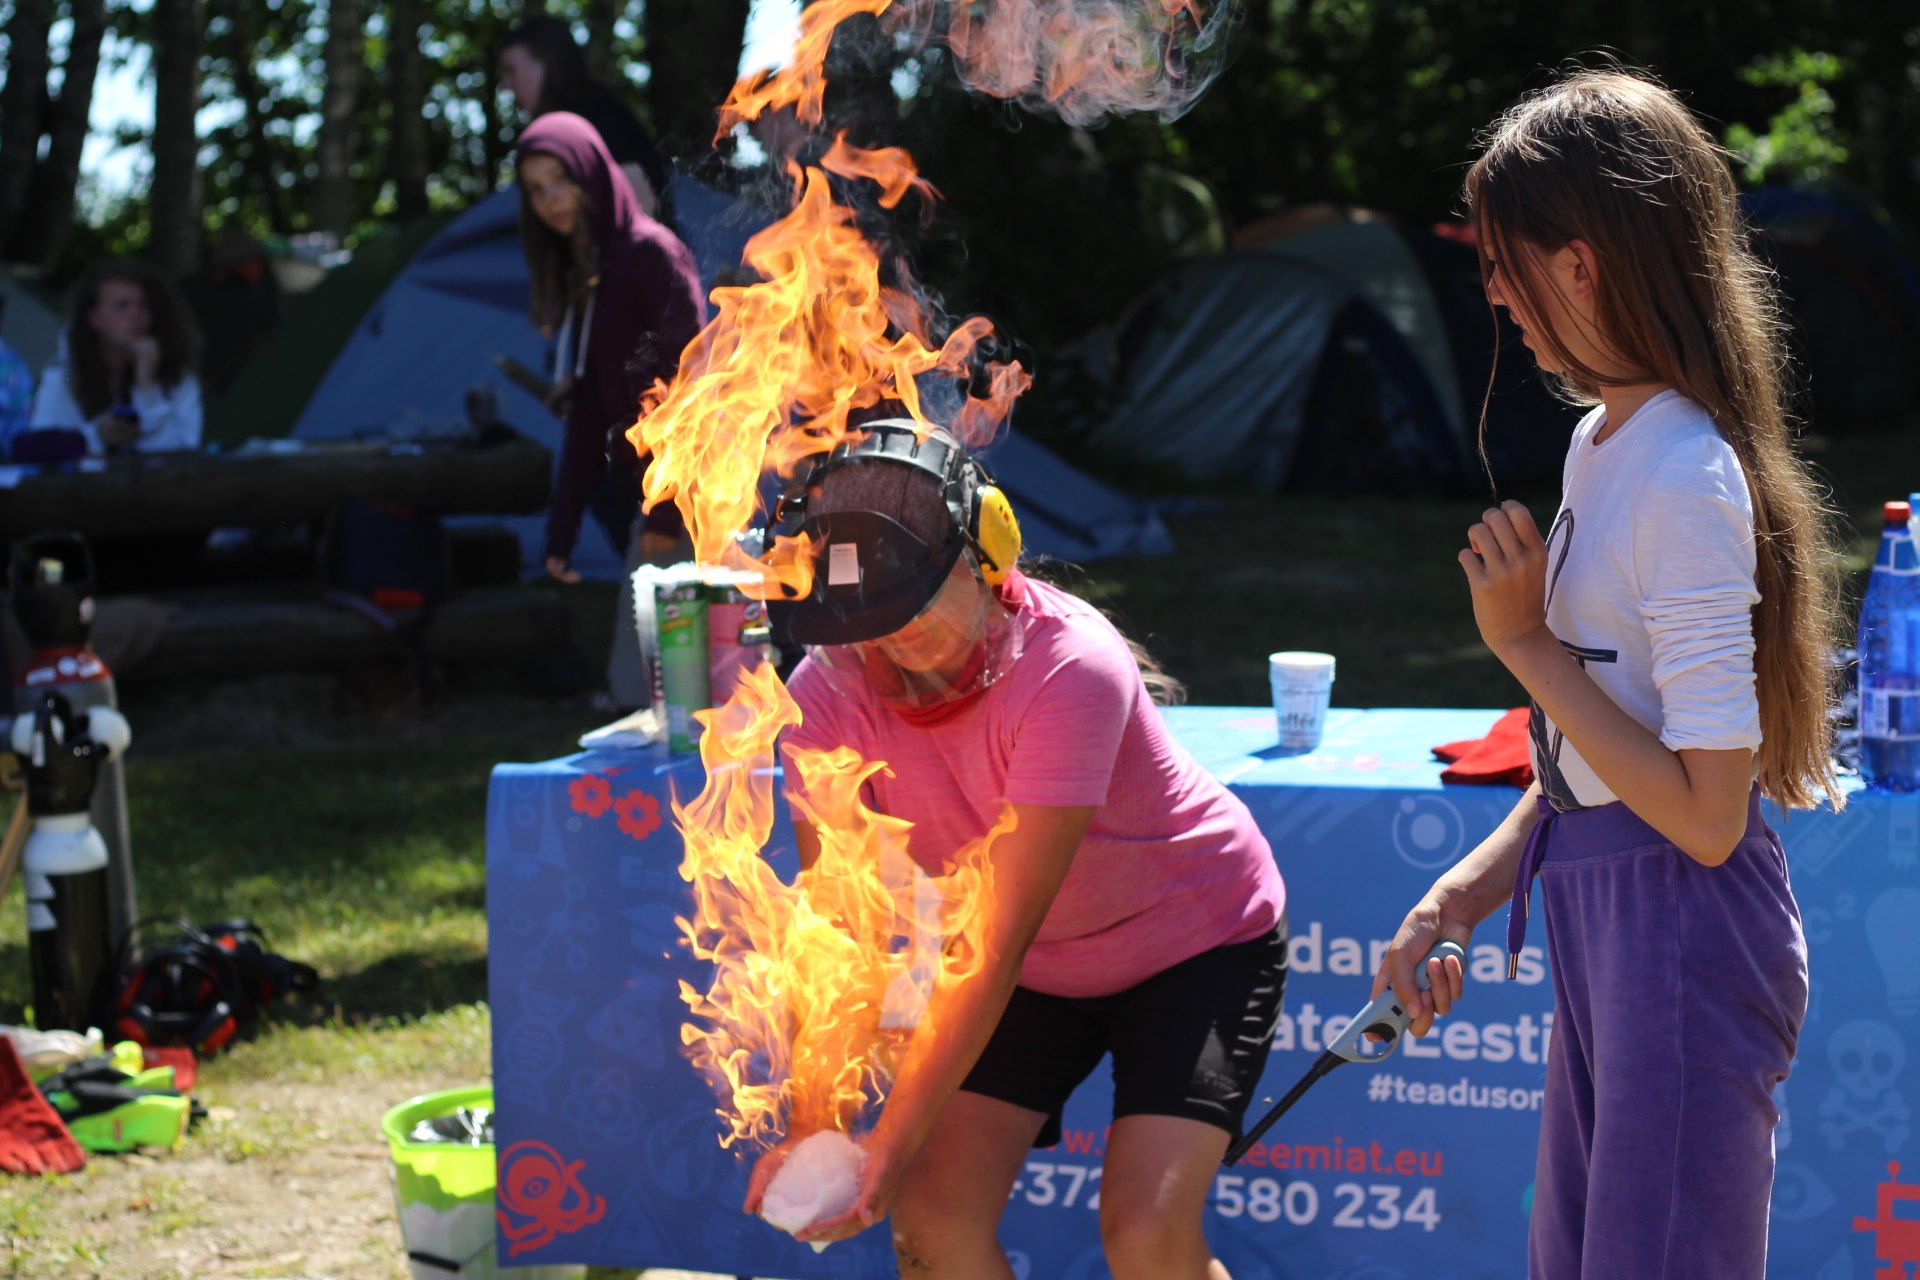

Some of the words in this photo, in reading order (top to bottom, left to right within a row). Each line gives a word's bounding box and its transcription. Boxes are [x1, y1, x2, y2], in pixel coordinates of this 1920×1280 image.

[1238, 1137, 1443, 1176] eemiat.eu
[1215, 1174, 1319, 1225] 580
[1333, 1183, 1441, 1231] 234
